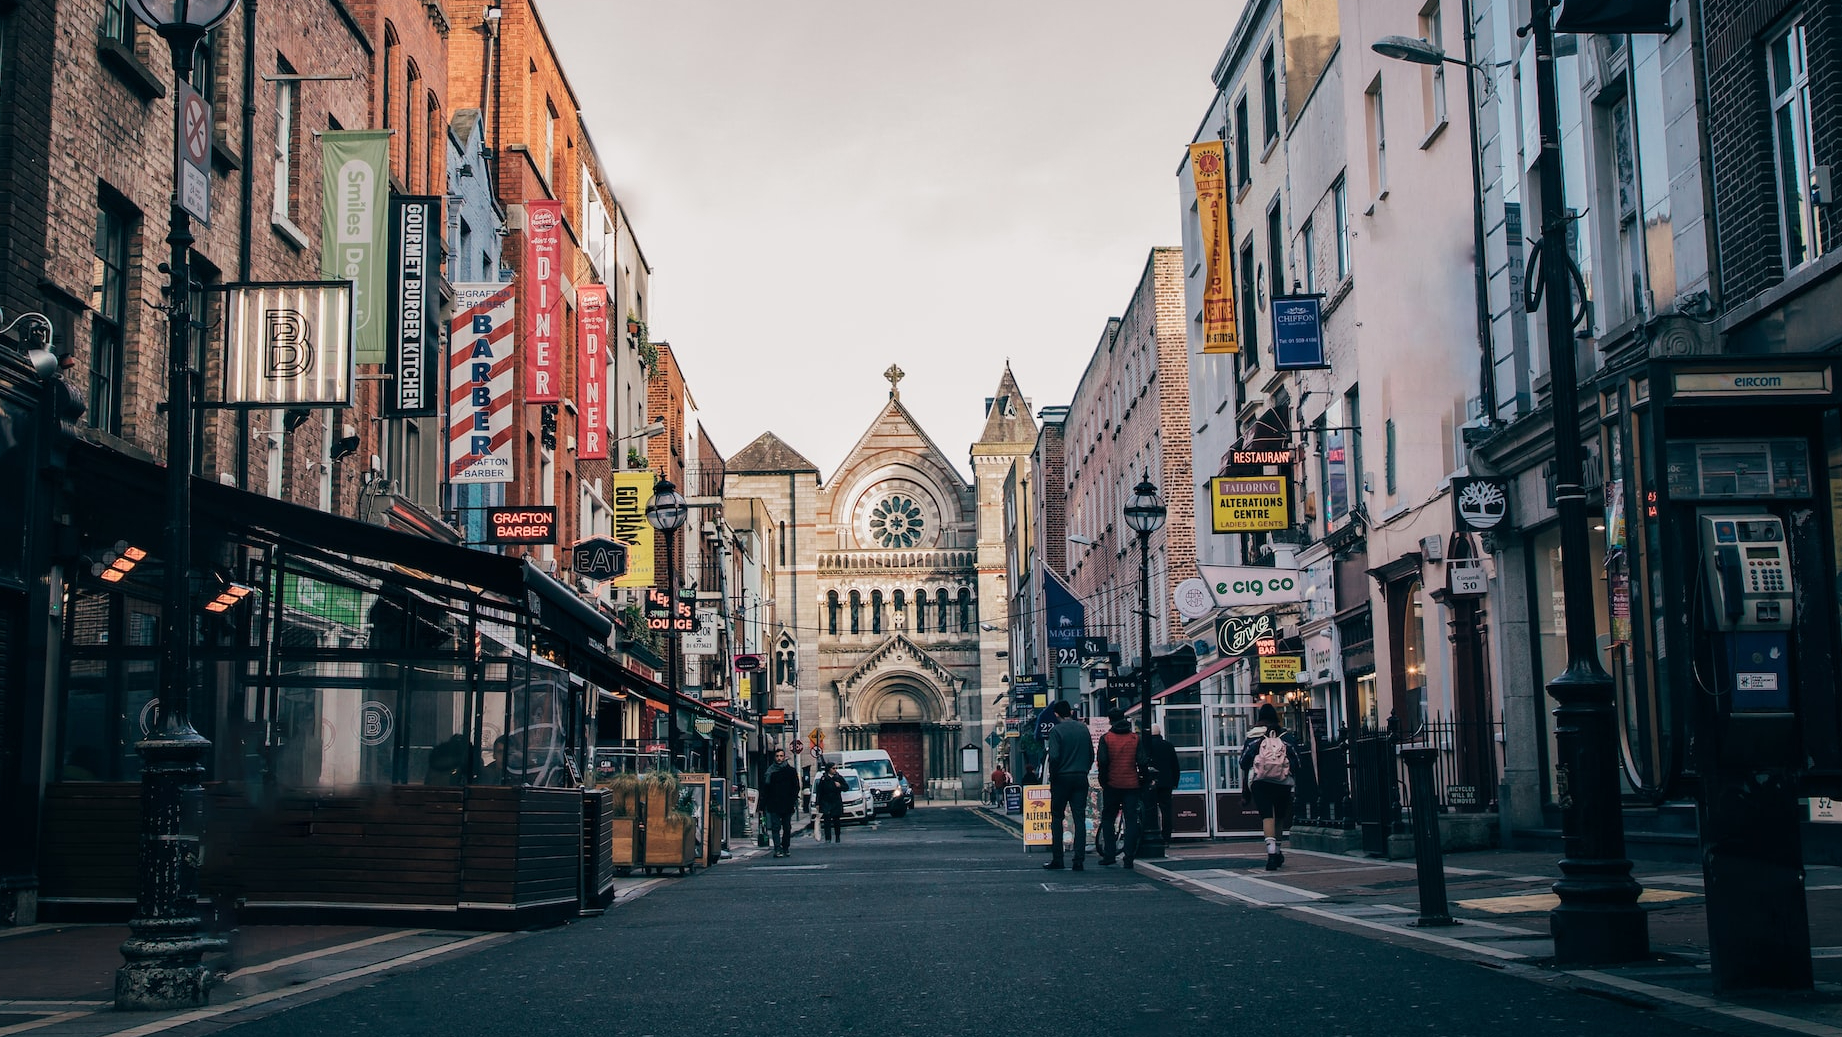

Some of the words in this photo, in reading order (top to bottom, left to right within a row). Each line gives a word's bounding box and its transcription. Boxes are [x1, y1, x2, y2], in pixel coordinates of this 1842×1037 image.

[346, 170, 367, 236] Smiles
[405, 203, 422, 276] GOURMET
[465, 290, 511, 298] GRAFTON
[403, 279, 420, 339] BURGER
[535, 256, 551, 395] DINER
[1277, 315, 1315, 323] CHIFFON
[264, 309, 315, 378] B
[402, 342, 420, 409] KITCHEN
[471, 314, 494, 456] BARBER
[586, 333, 599, 452] DINER
[463, 458, 508, 466] GRAFTON
[1233, 451, 1290, 464] RESTAURANT
[465, 470, 504, 478] BARBER
[1224, 483, 1276, 494] TAILORING
[1220, 498, 1283, 508] ALTERATIONS
[493, 512, 553, 525] GRAFTON
[1234, 509, 1270, 519] CENTRE
[496, 525, 549, 538] BARBER
[575, 547, 622, 573] EAT
[1216, 582, 1228, 595] e
[1233, 580, 1263, 597] cig
[1268, 578, 1294, 591] co
[1462, 582, 1477, 590] 30
[1049, 629, 1083, 638] MAGEE
[1058, 648, 1078, 664] 22
[1258, 646, 1276, 655] BAR
